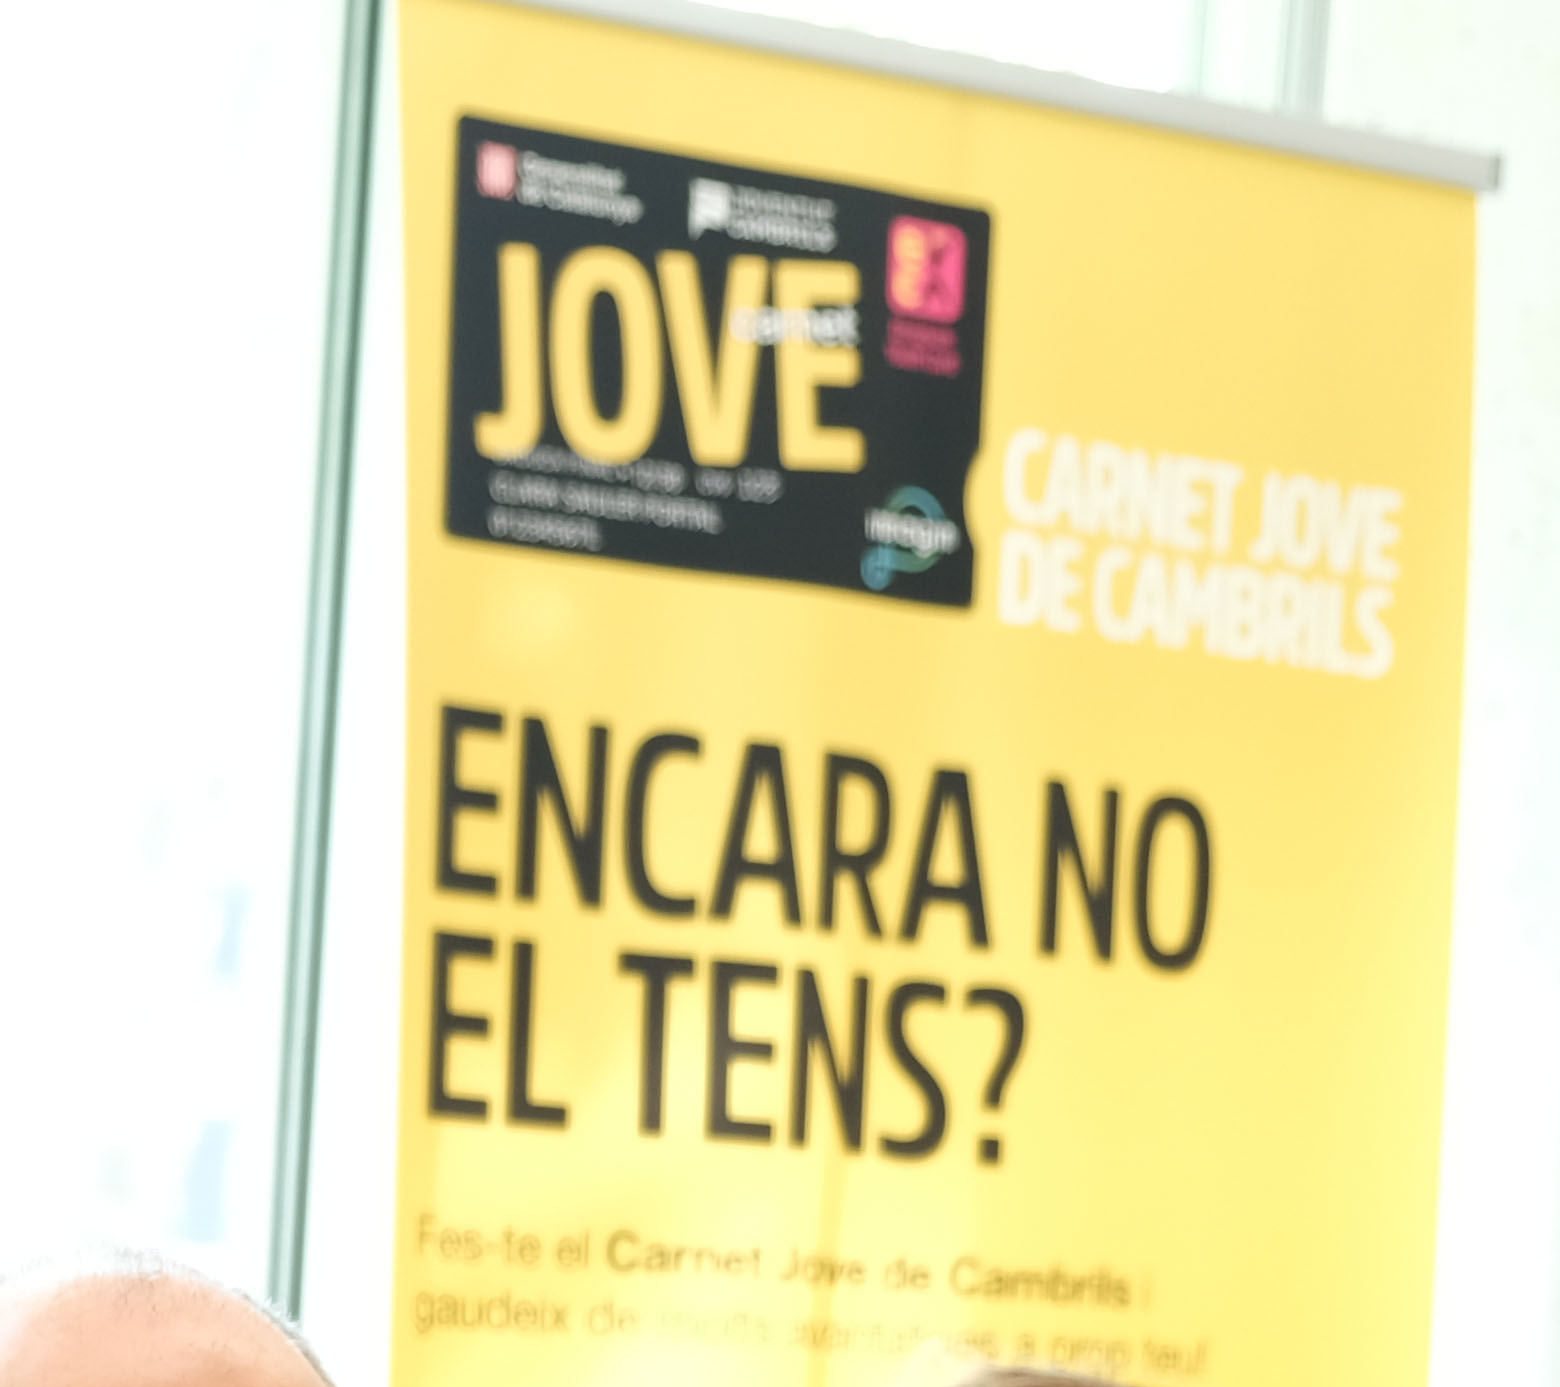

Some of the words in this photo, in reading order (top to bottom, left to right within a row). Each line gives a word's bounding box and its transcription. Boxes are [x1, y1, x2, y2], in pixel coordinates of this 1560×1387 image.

[473, 241, 867, 472] JOVE
[1003, 427, 1246, 552] CARNET
[1253, 470, 1404, 580] JOVE
[998, 533, 1081, 634] DE
[1090, 542, 1395, 679] CAMBRILS
[433, 702, 992, 951] ENCARA
[1038, 776, 1213, 973] NO
[426, 926, 572, 1131] EL
[617, 947, 1028, 1167] TENS?
[412, 1288, 570, 1337] gaudeix
[587, 1299, 642, 1337] de
[416, 1211, 542, 1266] Fes-te
[555, 1229, 591, 1270] el
[605, 1228, 762, 1277] Carnet
[780, 1247, 866, 1287] Jove
[883, 1257, 932, 1291] de
[948, 1255, 1132, 1311] Cambrils
